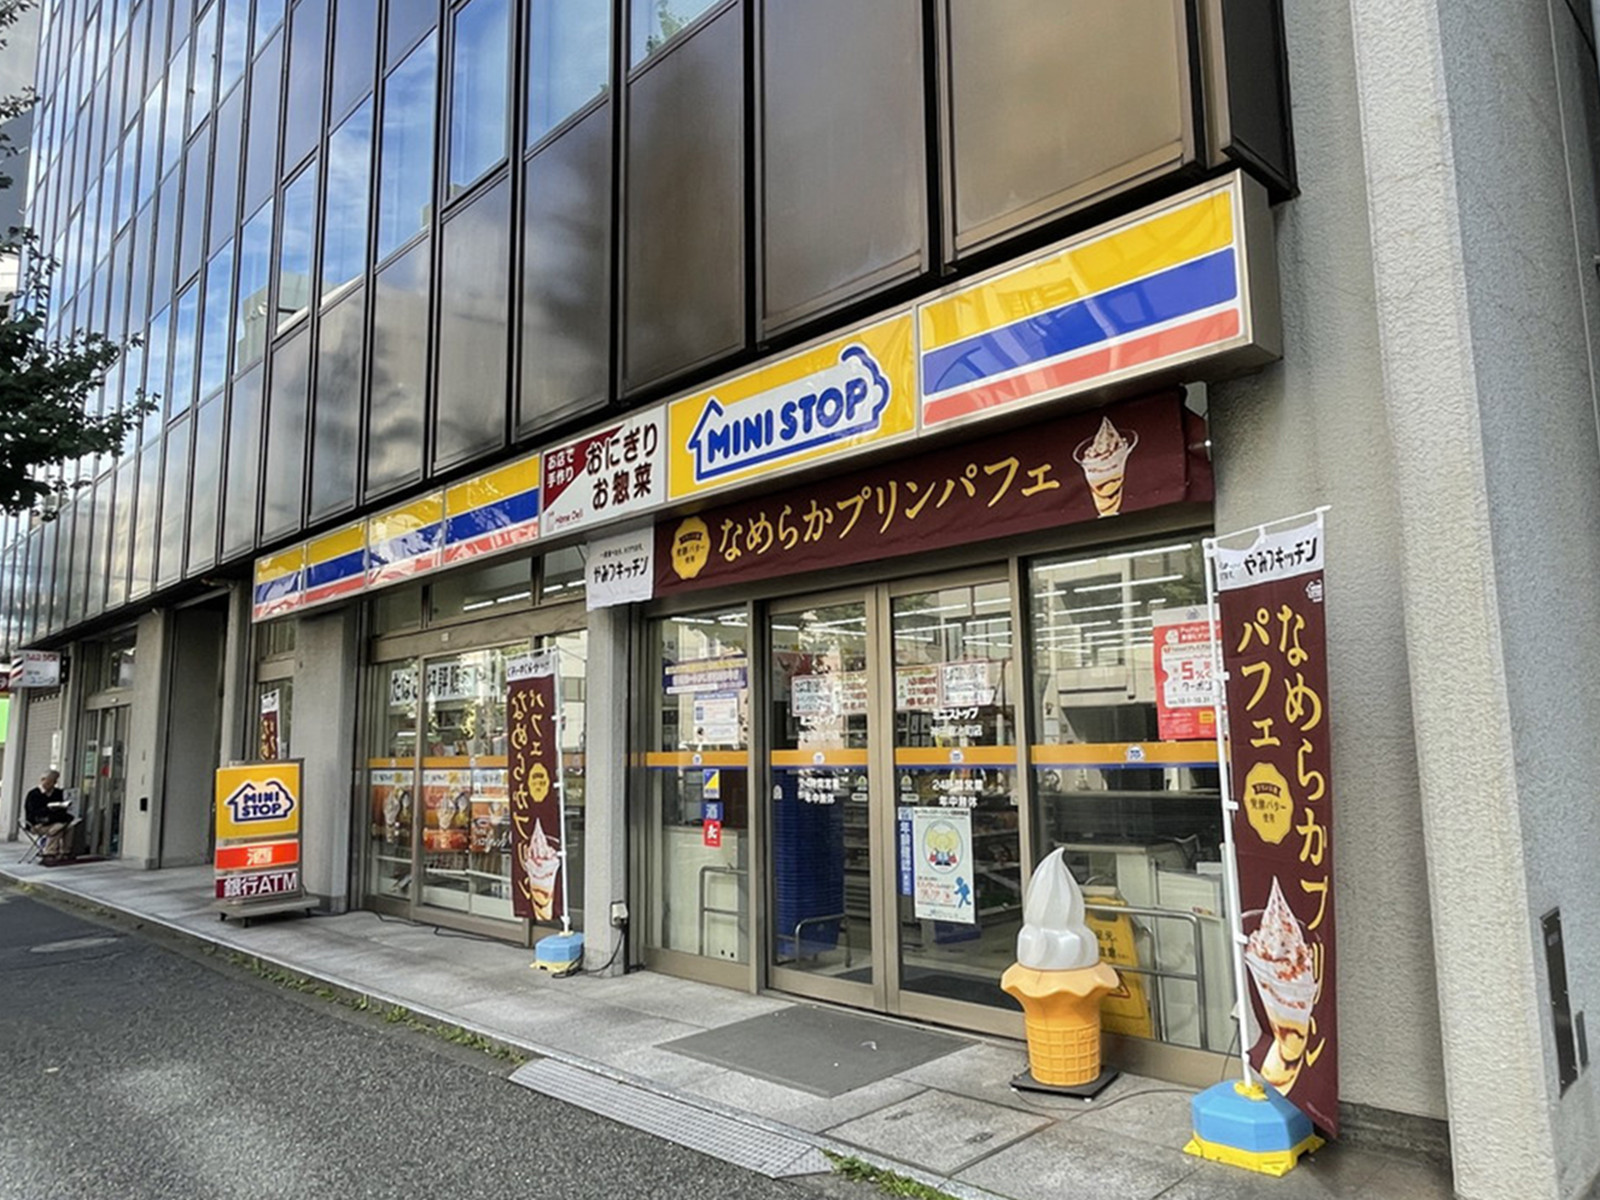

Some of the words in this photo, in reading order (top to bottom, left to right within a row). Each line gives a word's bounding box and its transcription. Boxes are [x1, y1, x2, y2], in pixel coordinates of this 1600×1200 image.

[707, 409, 774, 463] MINI
[780, 377, 869, 440] STOP
[547, 448, 576, 471] お店で
[586, 423, 658, 476] おにぎり
[547, 465, 574, 489] 手作り
[592, 461, 653, 511] お惣菜
[718, 456, 1062, 562] なめらかプリンパフェ
[1237, 606, 1282, 749] パフェ
[241, 803, 282, 817] STOP
[243, 790, 280, 804] MINI
[246, 846, 273, 866] 酒
